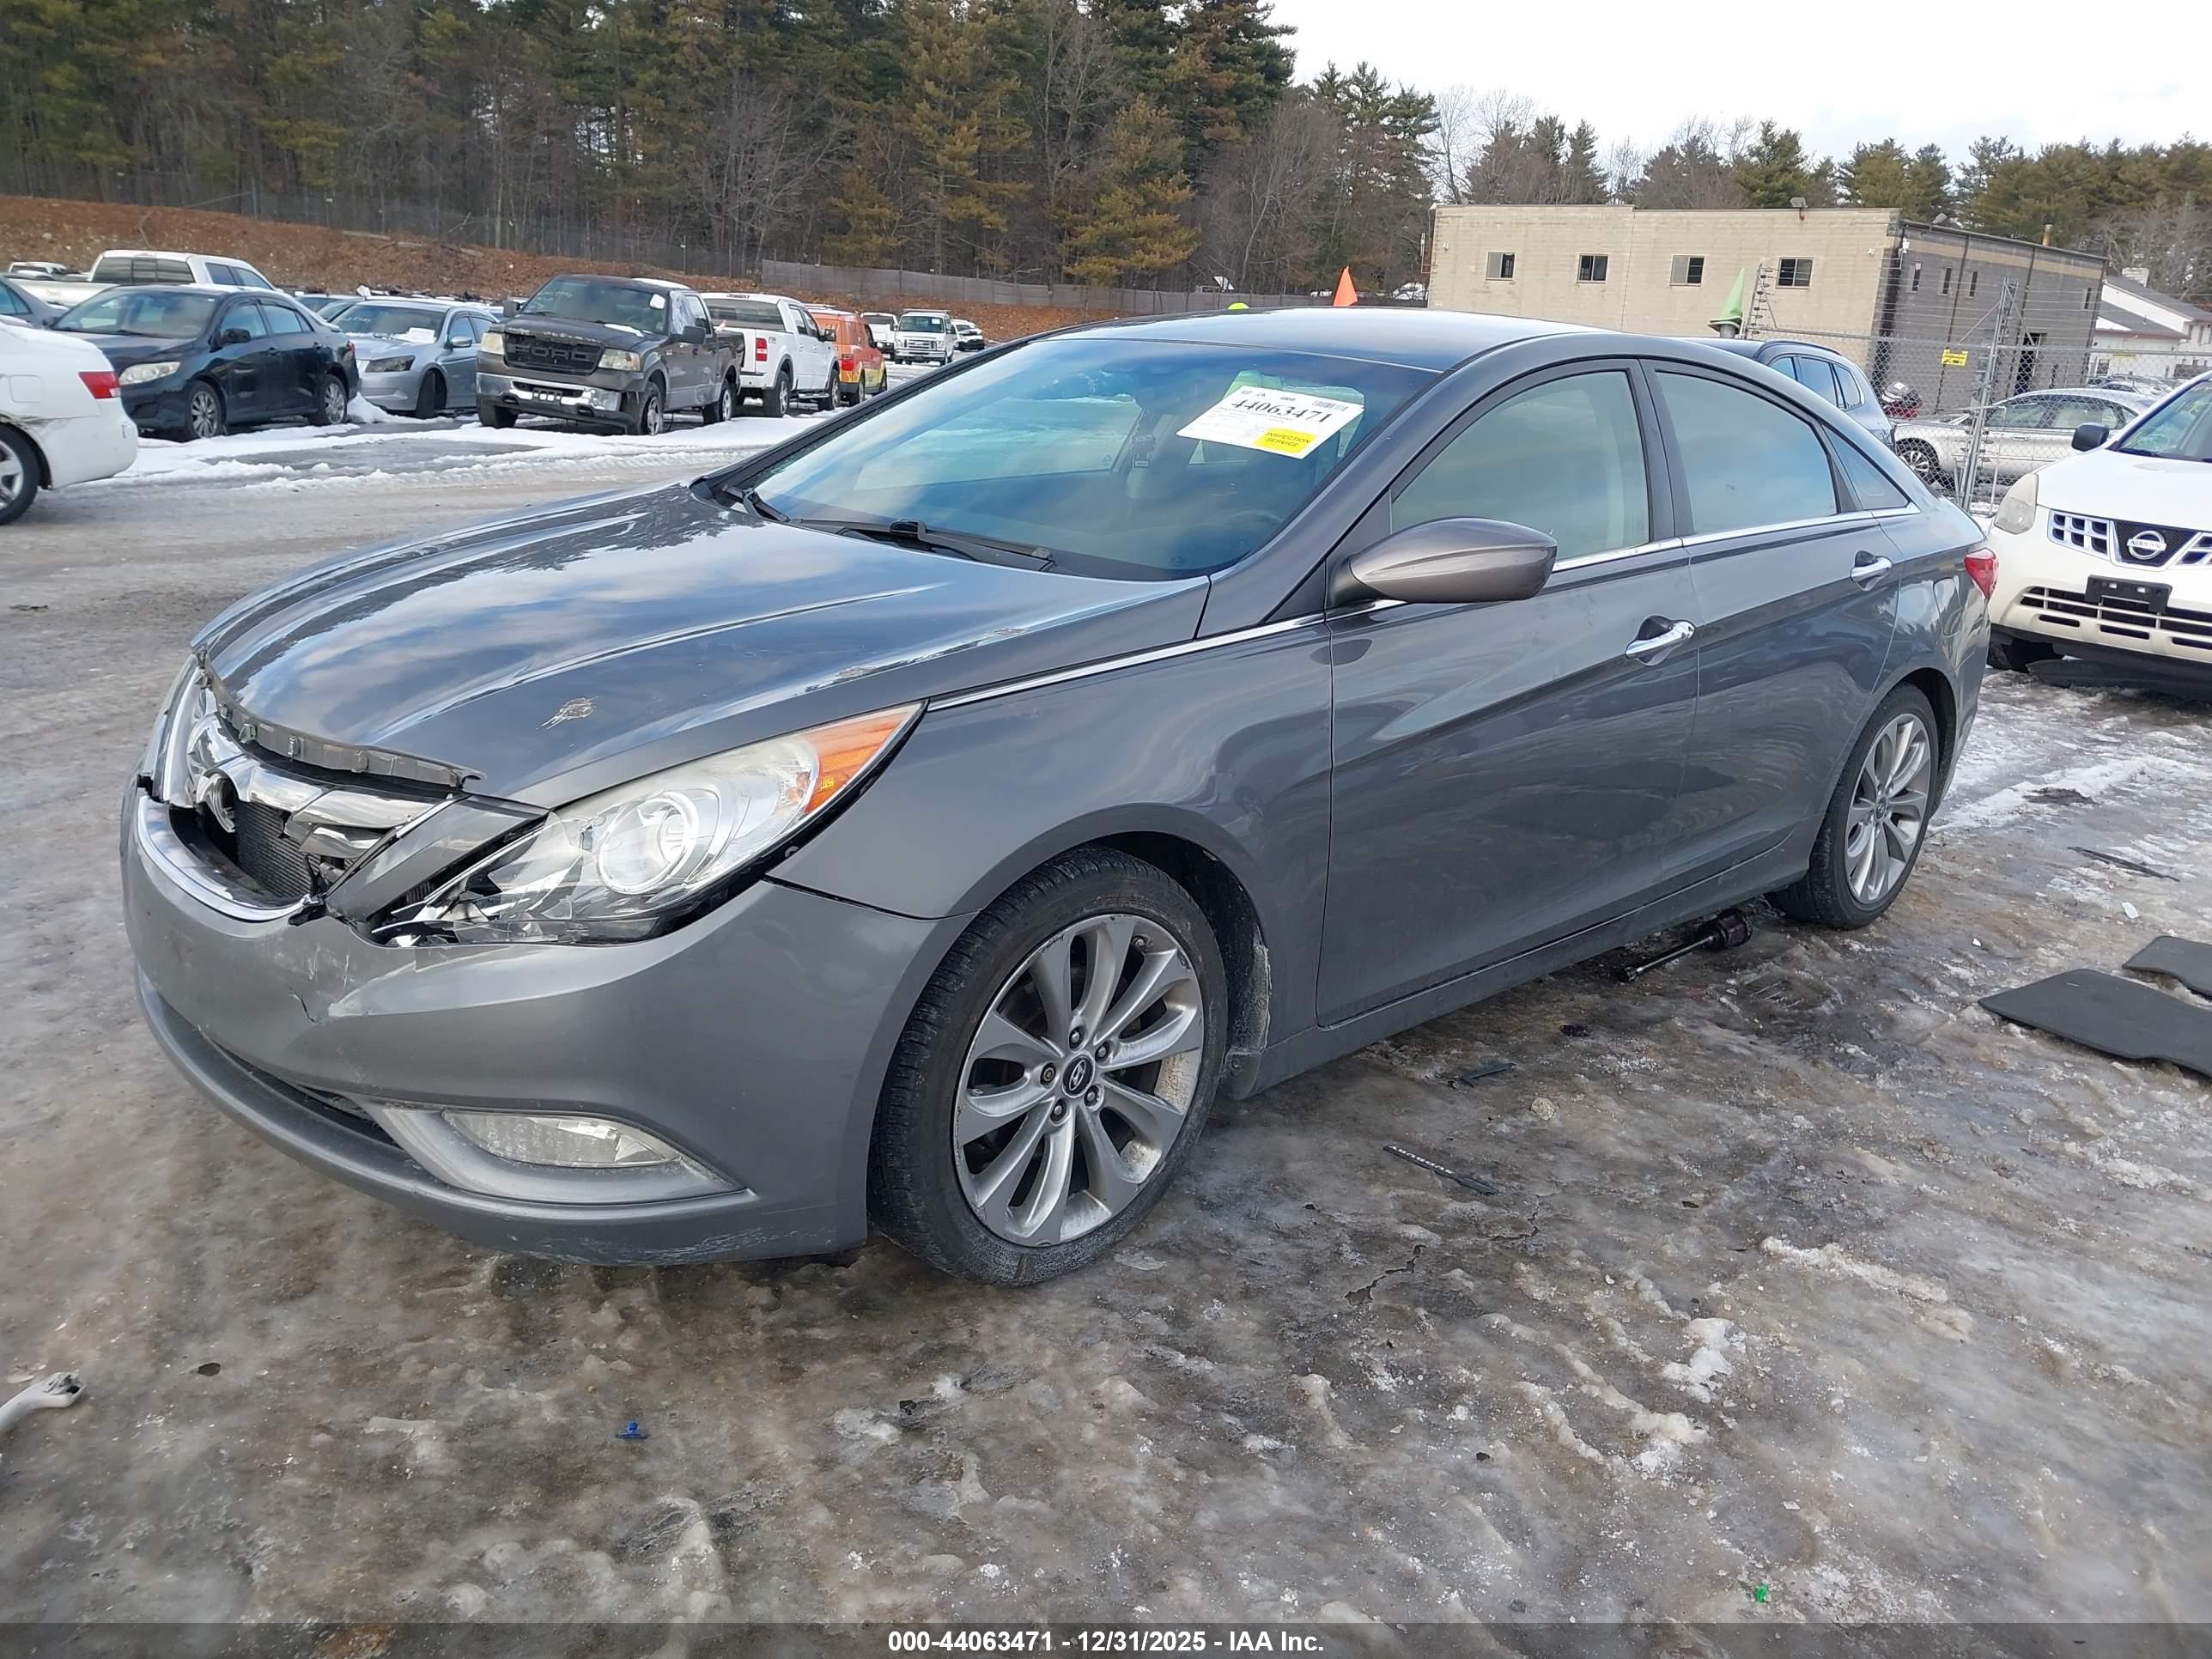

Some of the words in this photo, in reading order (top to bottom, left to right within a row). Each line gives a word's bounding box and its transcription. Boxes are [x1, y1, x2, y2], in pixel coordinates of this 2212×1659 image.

[507, 343, 592, 362] FORD
[1231, 399, 1333, 422] 44063471
[1266, 432, 1312, 444] INSPECTION
[1266, 438, 1300, 447] SERVICE
[2130, 540, 2161, 549] NISSAN
